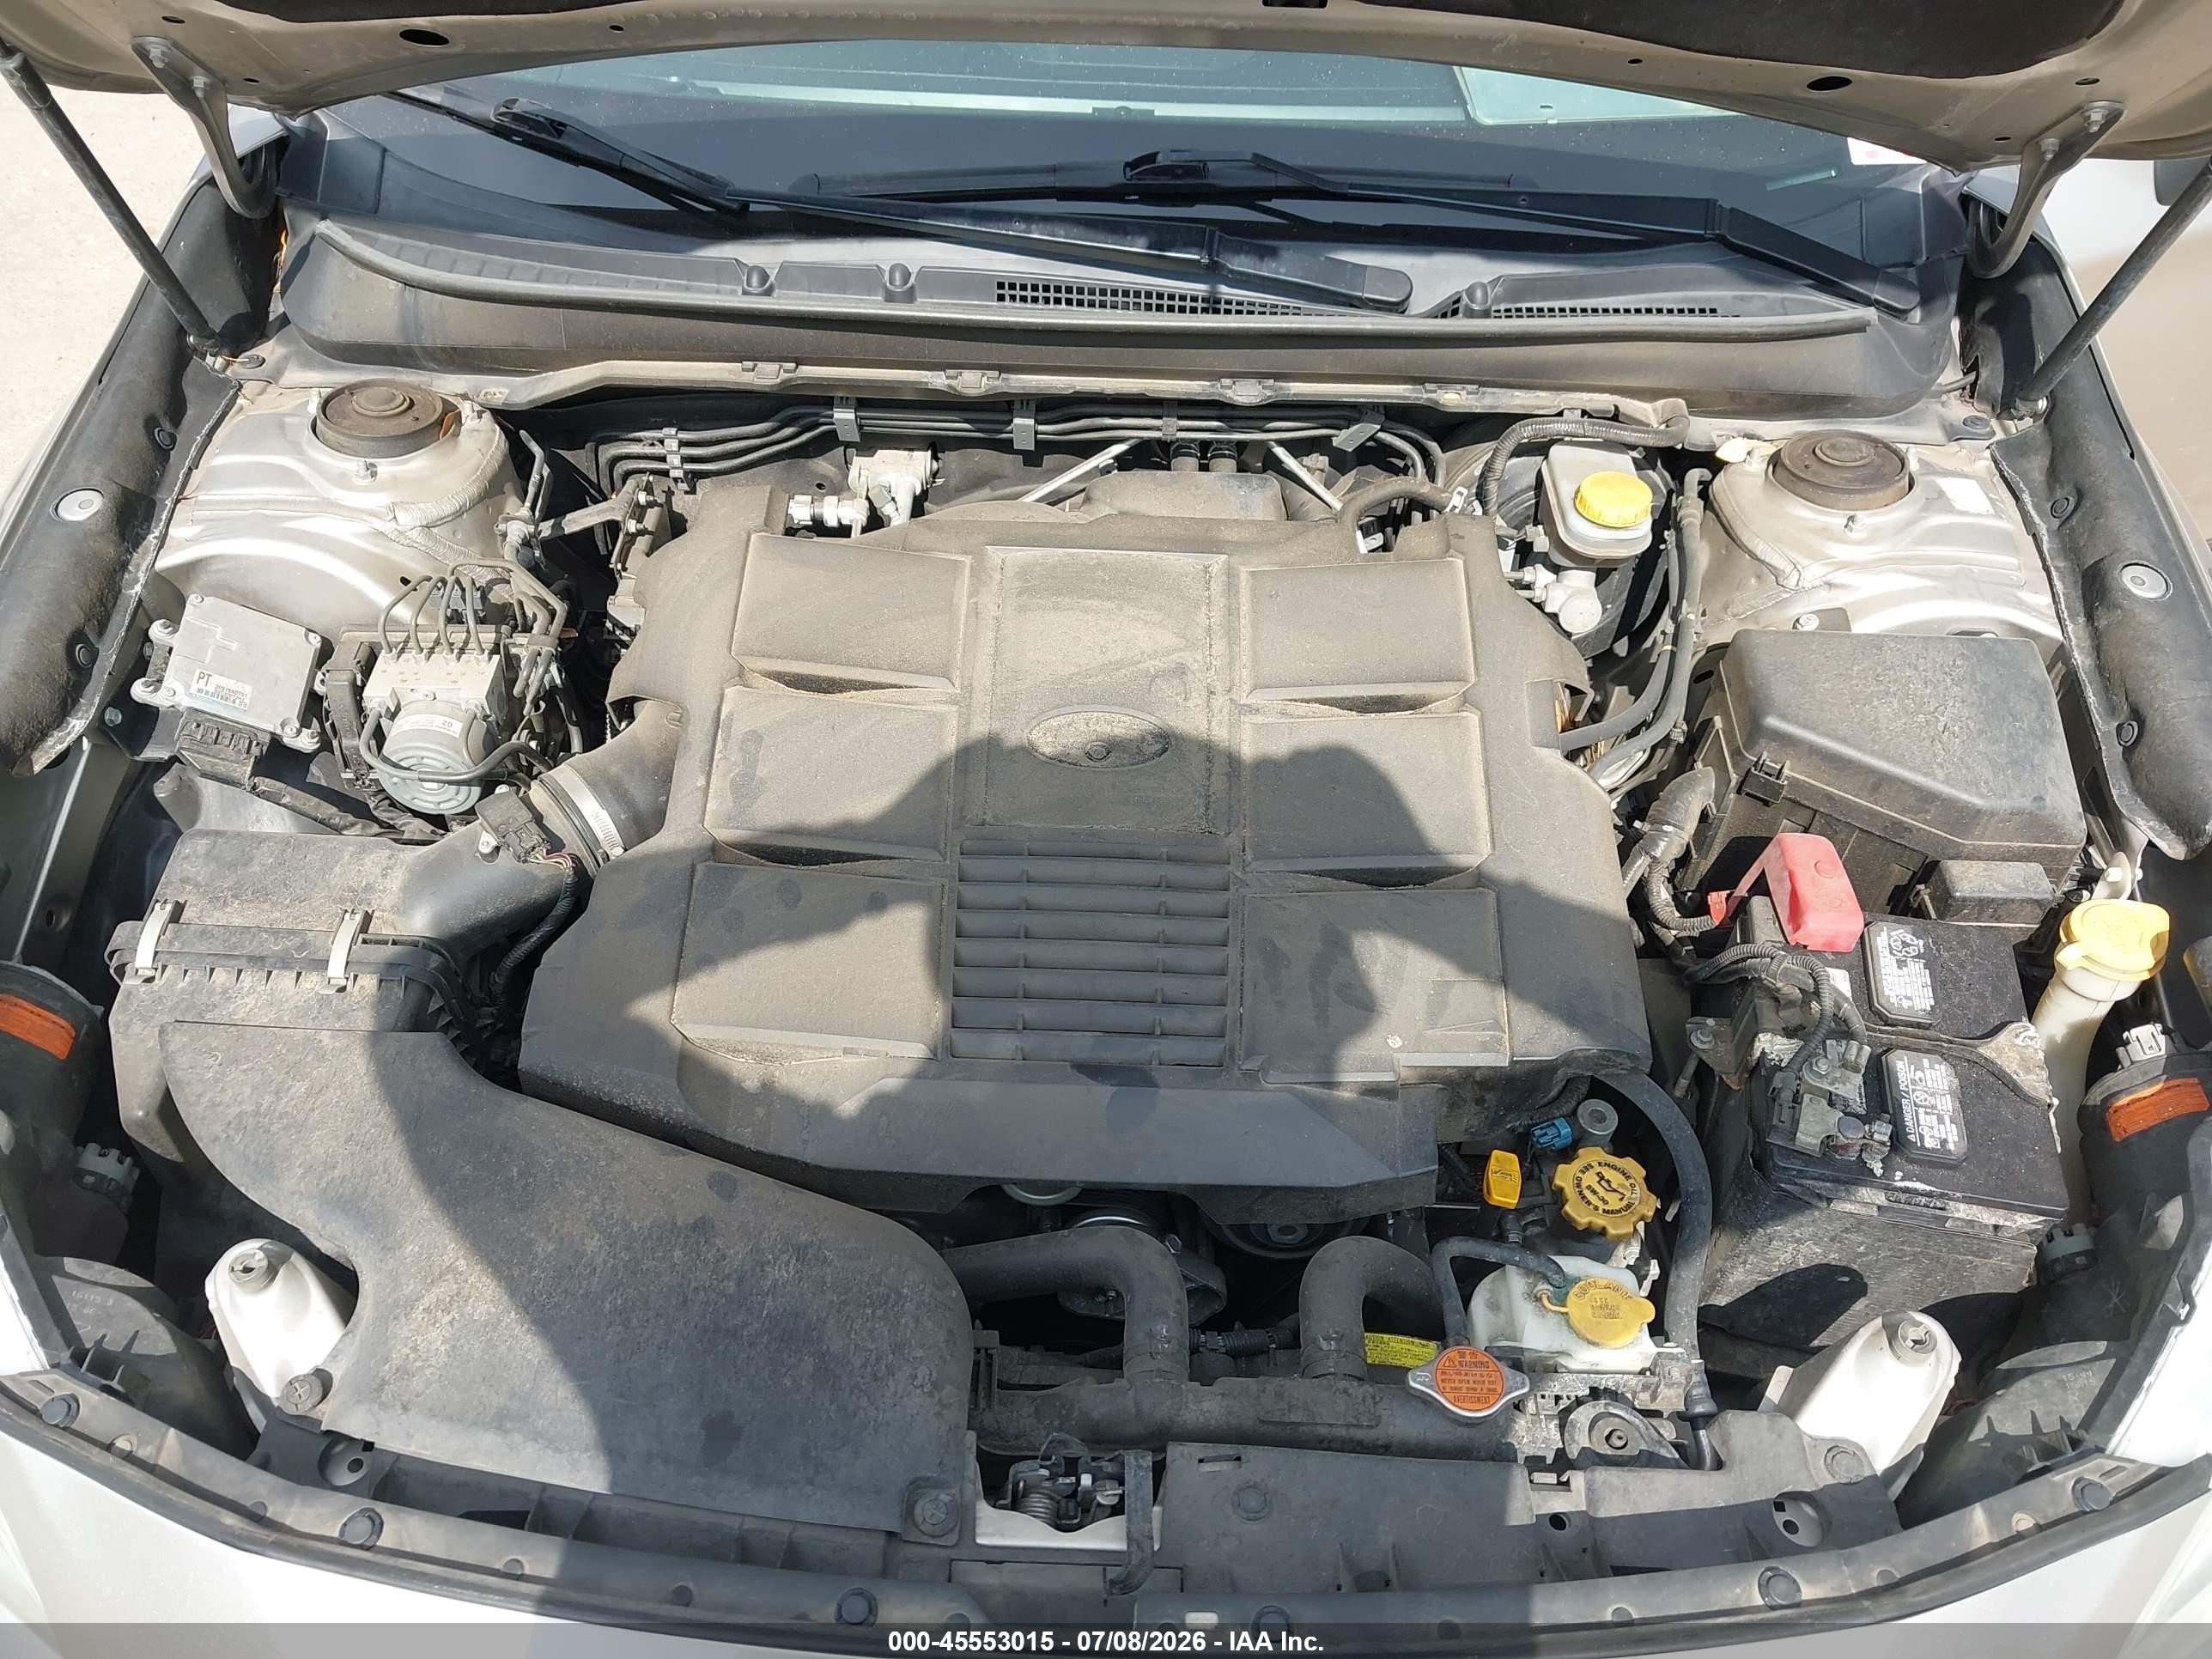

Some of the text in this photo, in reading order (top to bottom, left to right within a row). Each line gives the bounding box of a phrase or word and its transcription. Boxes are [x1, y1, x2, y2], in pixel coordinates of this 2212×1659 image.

[196, 672, 213, 687] PT
[1896, 1060, 1908, 1091] POISON
[1901, 1098, 1914, 1133] DANGER
[1575, 1164, 1636, 1215] SEE OWNER'S MANUAL
[1598, 1161, 1638, 1195] ENGINE OIL
[1585, 1184, 1609, 1205] 5W-30
[1572, 1279, 1633, 1299] COOLANT
[1458, 1360, 1490, 1369] WARNING
